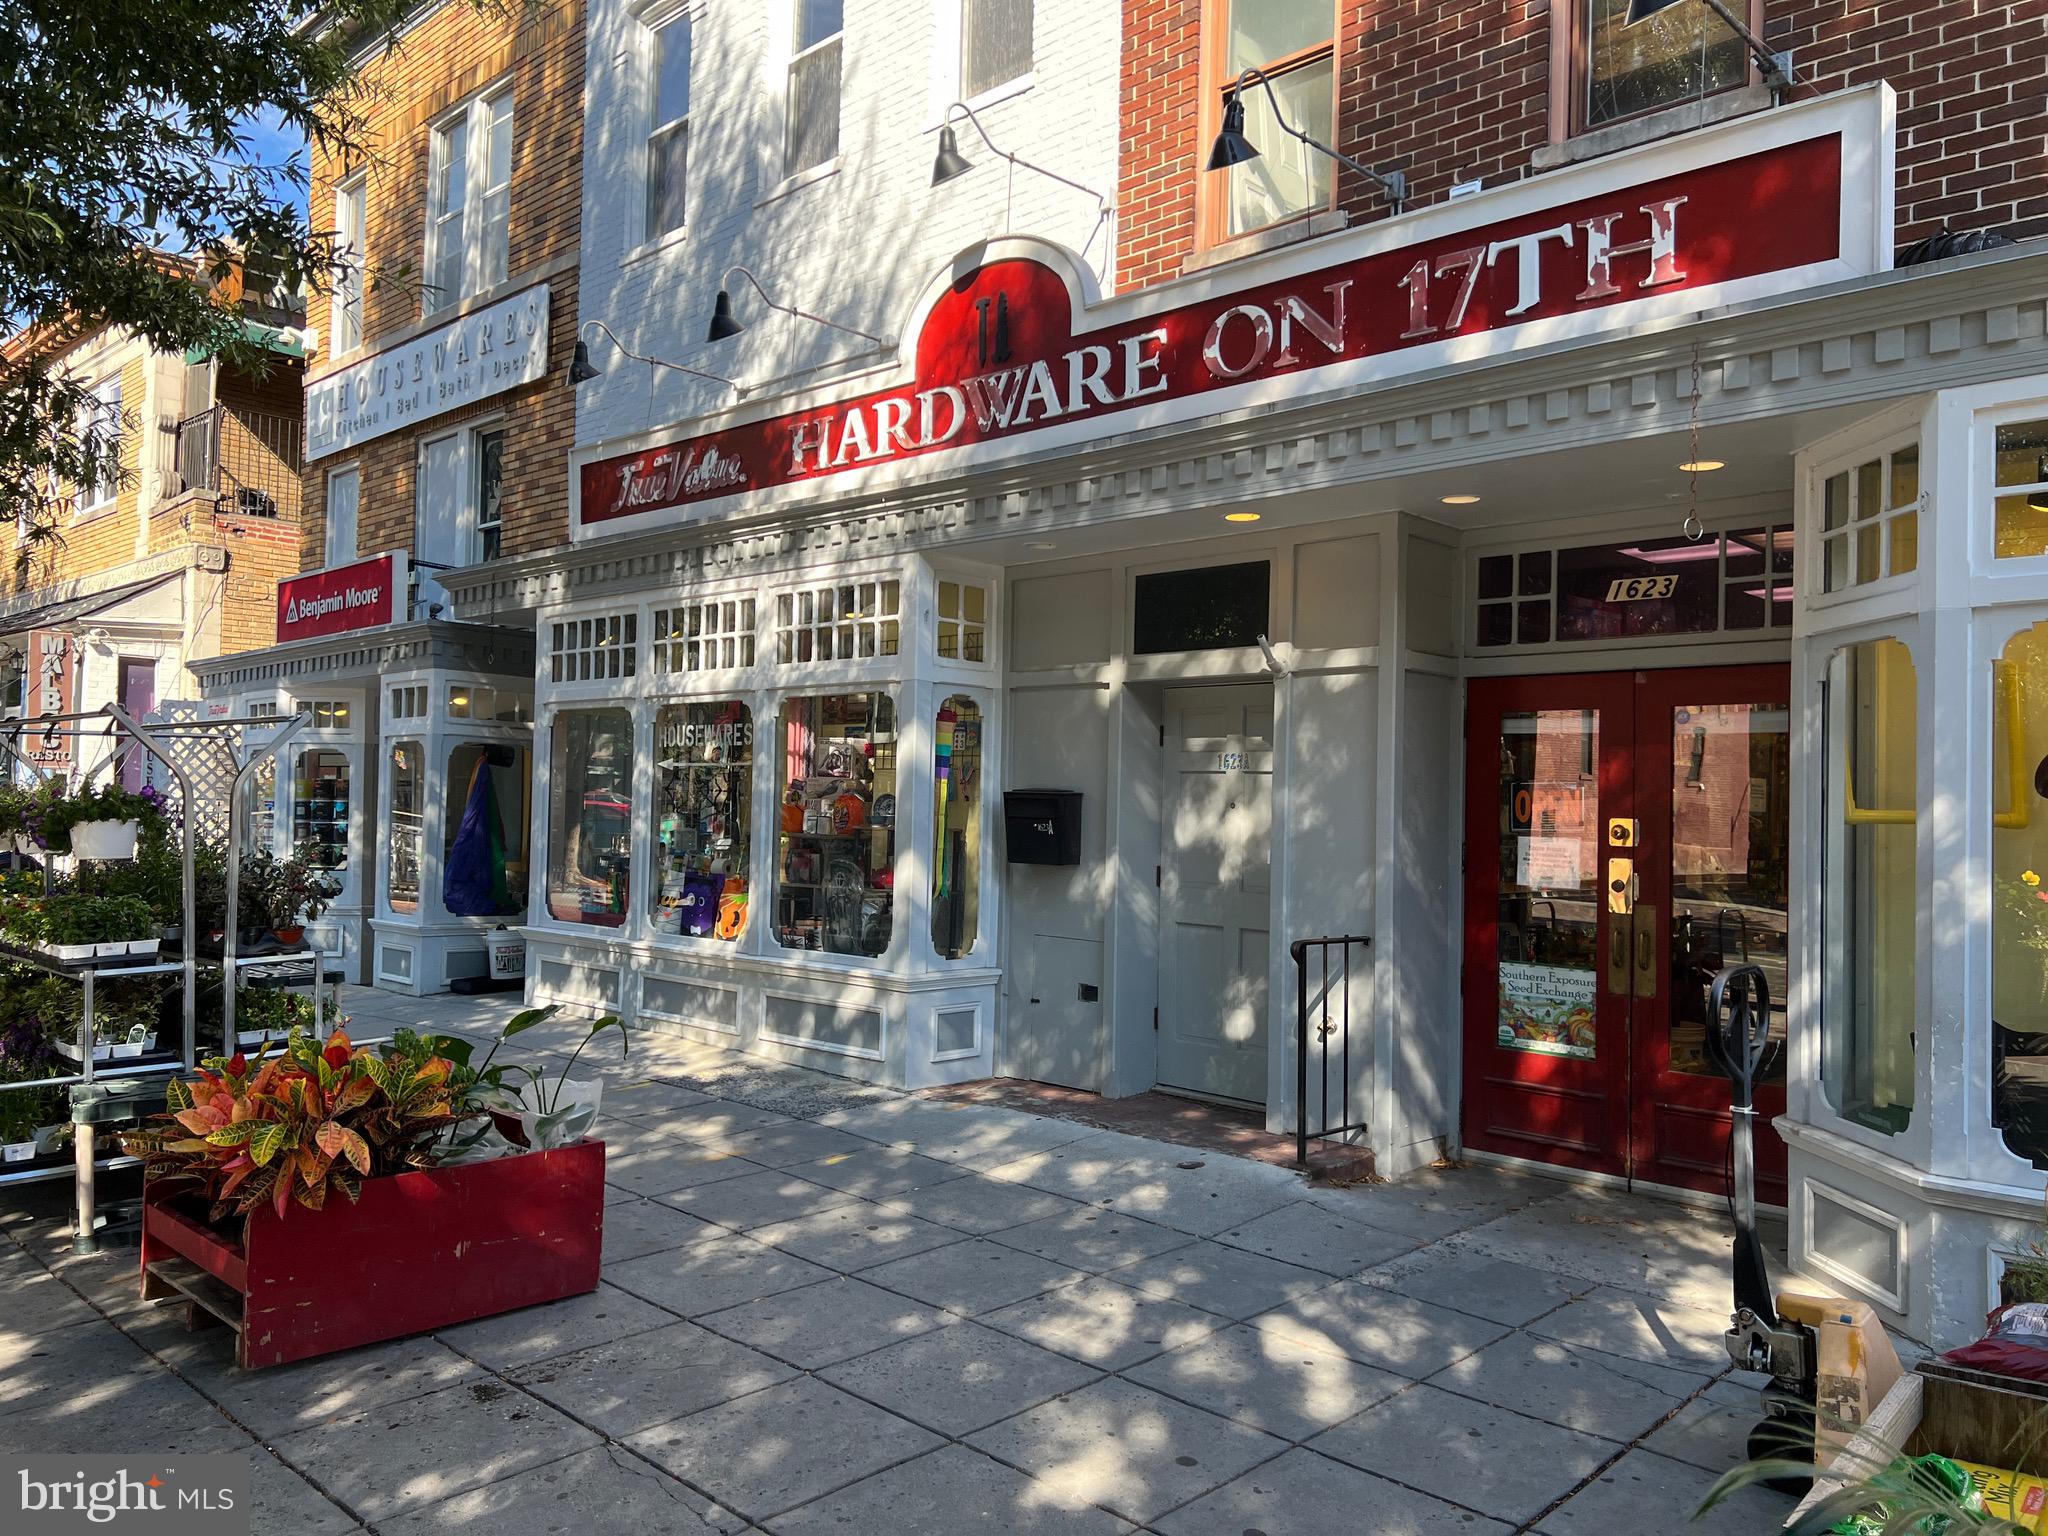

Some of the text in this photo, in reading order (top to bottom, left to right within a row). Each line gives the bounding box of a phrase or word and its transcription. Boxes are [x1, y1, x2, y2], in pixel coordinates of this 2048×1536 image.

[786, 195, 1689, 477] HARDWARE ON 17TH
[337, 301, 538, 413] HOUSEWARES
[335, 351, 537, 438] Kitchen Bed Bath Decor
[1613, 578, 1673, 600] 1623
[299, 591, 344, 620] Benjamin
[41, 636, 66, 750] MALBC
[659, 722, 753, 748] HOUSEWARES
[28, 750, 73, 762] RESTO
[1500, 967, 1597, 988] Southern Exposure
[1508, 980, 1588, 1001] Seed Exchange
